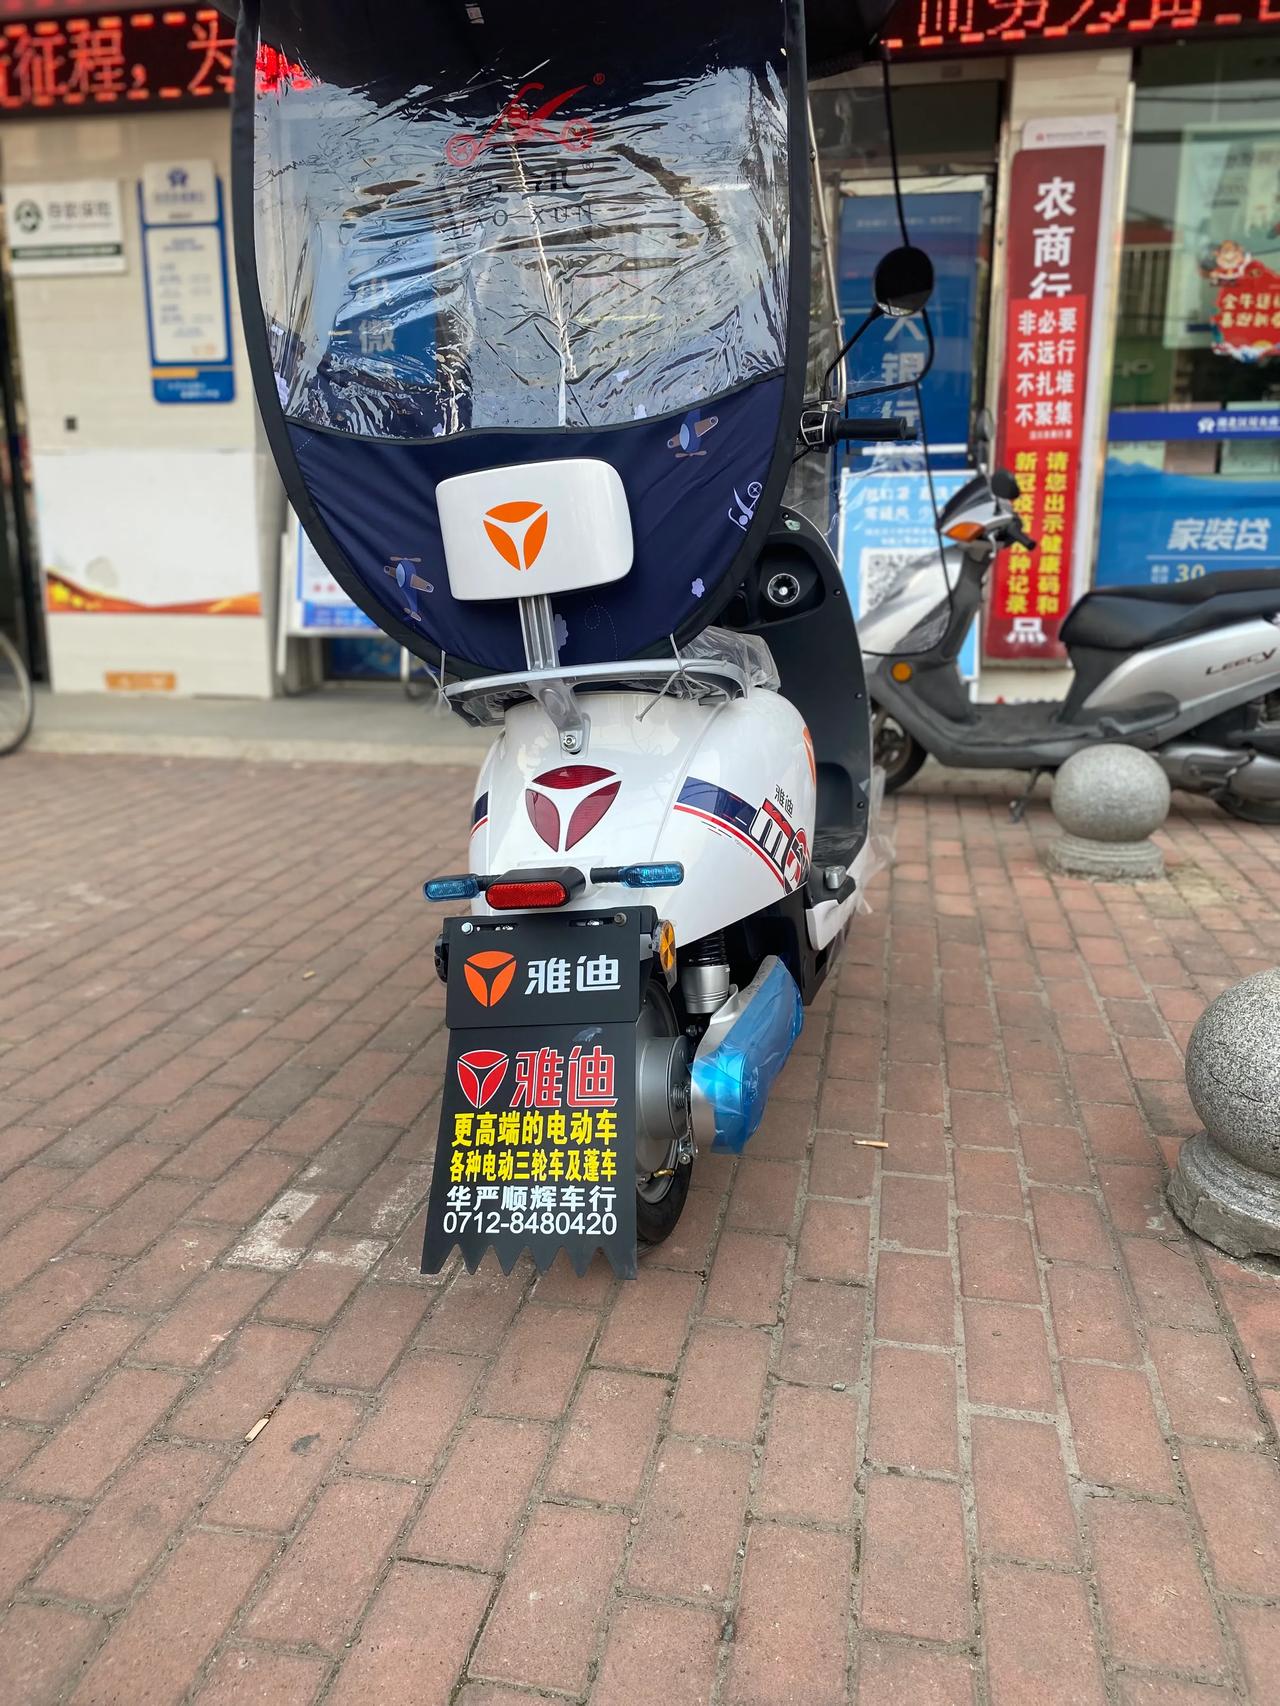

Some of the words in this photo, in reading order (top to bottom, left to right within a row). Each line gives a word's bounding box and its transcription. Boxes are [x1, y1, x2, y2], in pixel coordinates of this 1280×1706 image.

[1017, 307, 1077, 336] 非必要
[1016, 339, 1076, 367] 不远行
[1015, 370, 1075, 397] 不扎堆
[1014, 400, 1073, 427] 不聚集
[1166, 517, 1271, 551] 家装贷
[774, 784, 794, 818] 雅迪
[524, 954, 621, 995] 雅迪
[509, 1046, 619, 1108] 雅迪
[451, 1109, 618, 1147] 更高端的电动车
[449, 1148, 617, 1182] 各种电动三轮车及蓬车
[446, 1185, 617, 1213] 华严顺辉车行
[443, 1211, 617, 1236] 0712-8480420
